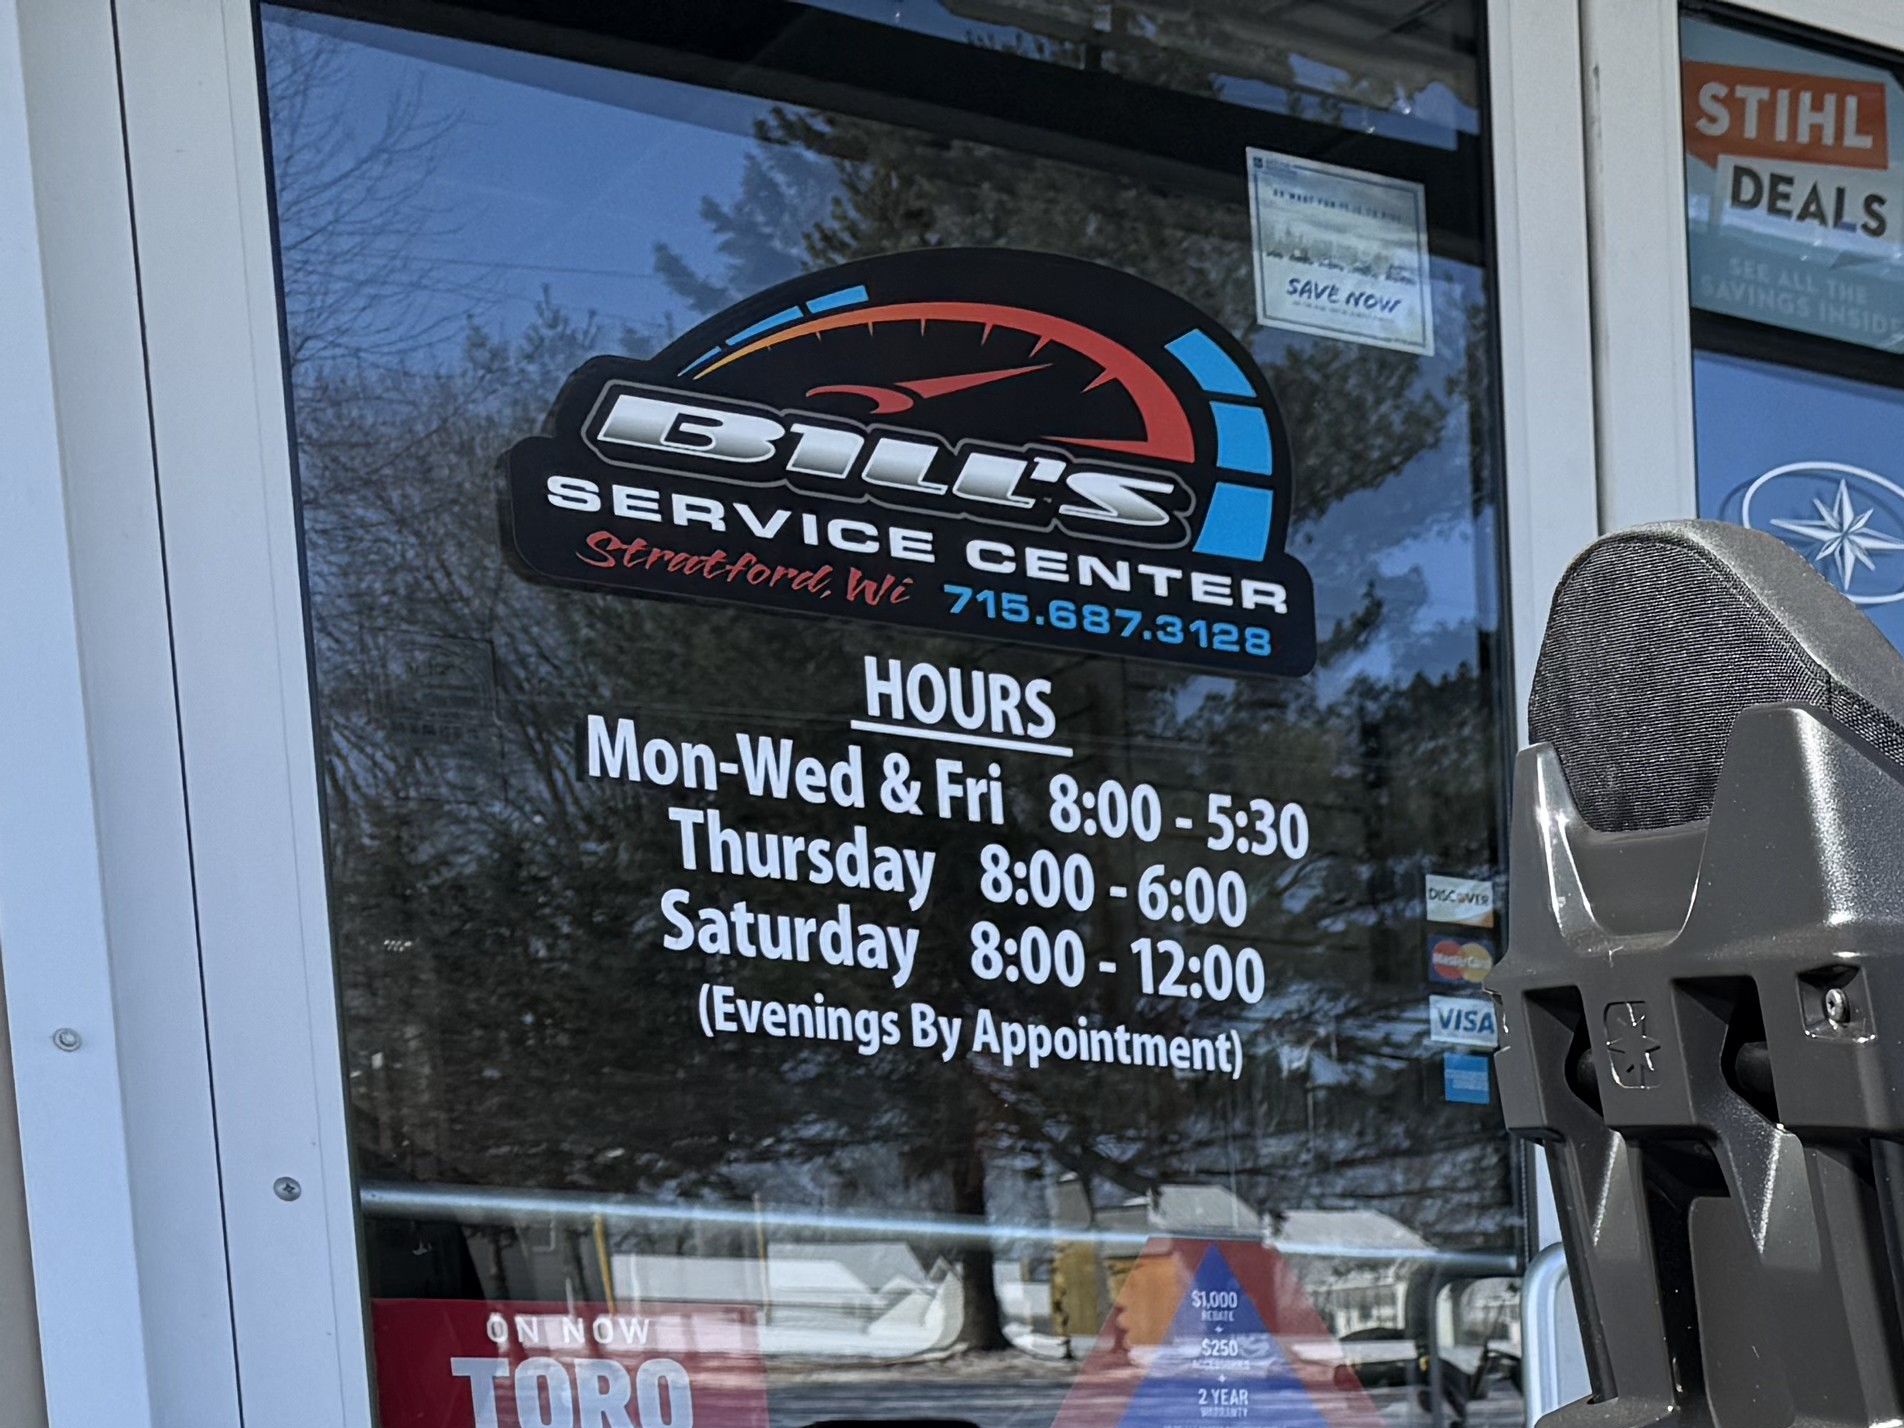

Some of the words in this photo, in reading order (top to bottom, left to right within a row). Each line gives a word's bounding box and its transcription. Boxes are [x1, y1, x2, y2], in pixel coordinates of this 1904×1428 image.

[1696, 82, 1873, 150] STIHL
[1730, 165, 1887, 237] DEALS
[1286, 278, 1340, 303] SAVE
[1345, 291, 1402, 314] NOW
[1728, 257, 1769, 284] SEE
[1777, 263, 1819, 293] ALL
[598, 392, 1178, 528] BILL'S
[546, 475, 936, 565] SERVICE
[965, 539, 1289, 615] CENTER
[575, 530, 831, 600] Stratford,
[843, 567, 914, 607] Wi
[942, 584, 1273, 658] 715.687.3128
[864, 656, 1055, 739] HOURS
[586, 714, 864, 809] Mon-Wed
[880, 752, 922, 816] &
[936, 758, 1004, 826] Fri
[1048, 772, 1161, 843] 8:00
[1175, 815, 1193, 831] -
[1206, 793, 1310, 860] 5:30
[668, 806, 936, 911] Thursday
[979, 842, 1094, 911] 8:00
[1109, 884, 1128, 899] -
[1137, 864, 1247, 928] 6:00
[1428, 887, 1491, 906] DISCOVER
[660, 888, 920, 989] Saturday
[970, 920, 1086, 988] 8:00
[1099, 960, 1116, 974] -
[1130, 936, 1266, 1005] 12:00
[698, 982, 901, 1055] (Evenings
[911, 1002, 962, 1063] By
[972, 1008, 1245, 1080] Appointment)
[1437, 1009, 1495, 1035] VISA
[487, 1314, 541, 1345] ON
[562, 1317, 651, 1346] NOW
[1191, 1289, 1238, 1310] $1,000
[1202, 1337, 1239, 1357] $250
[1198, 1388, 1208, 1405] 2
[1211, 1388, 1249, 1405] YEAR
